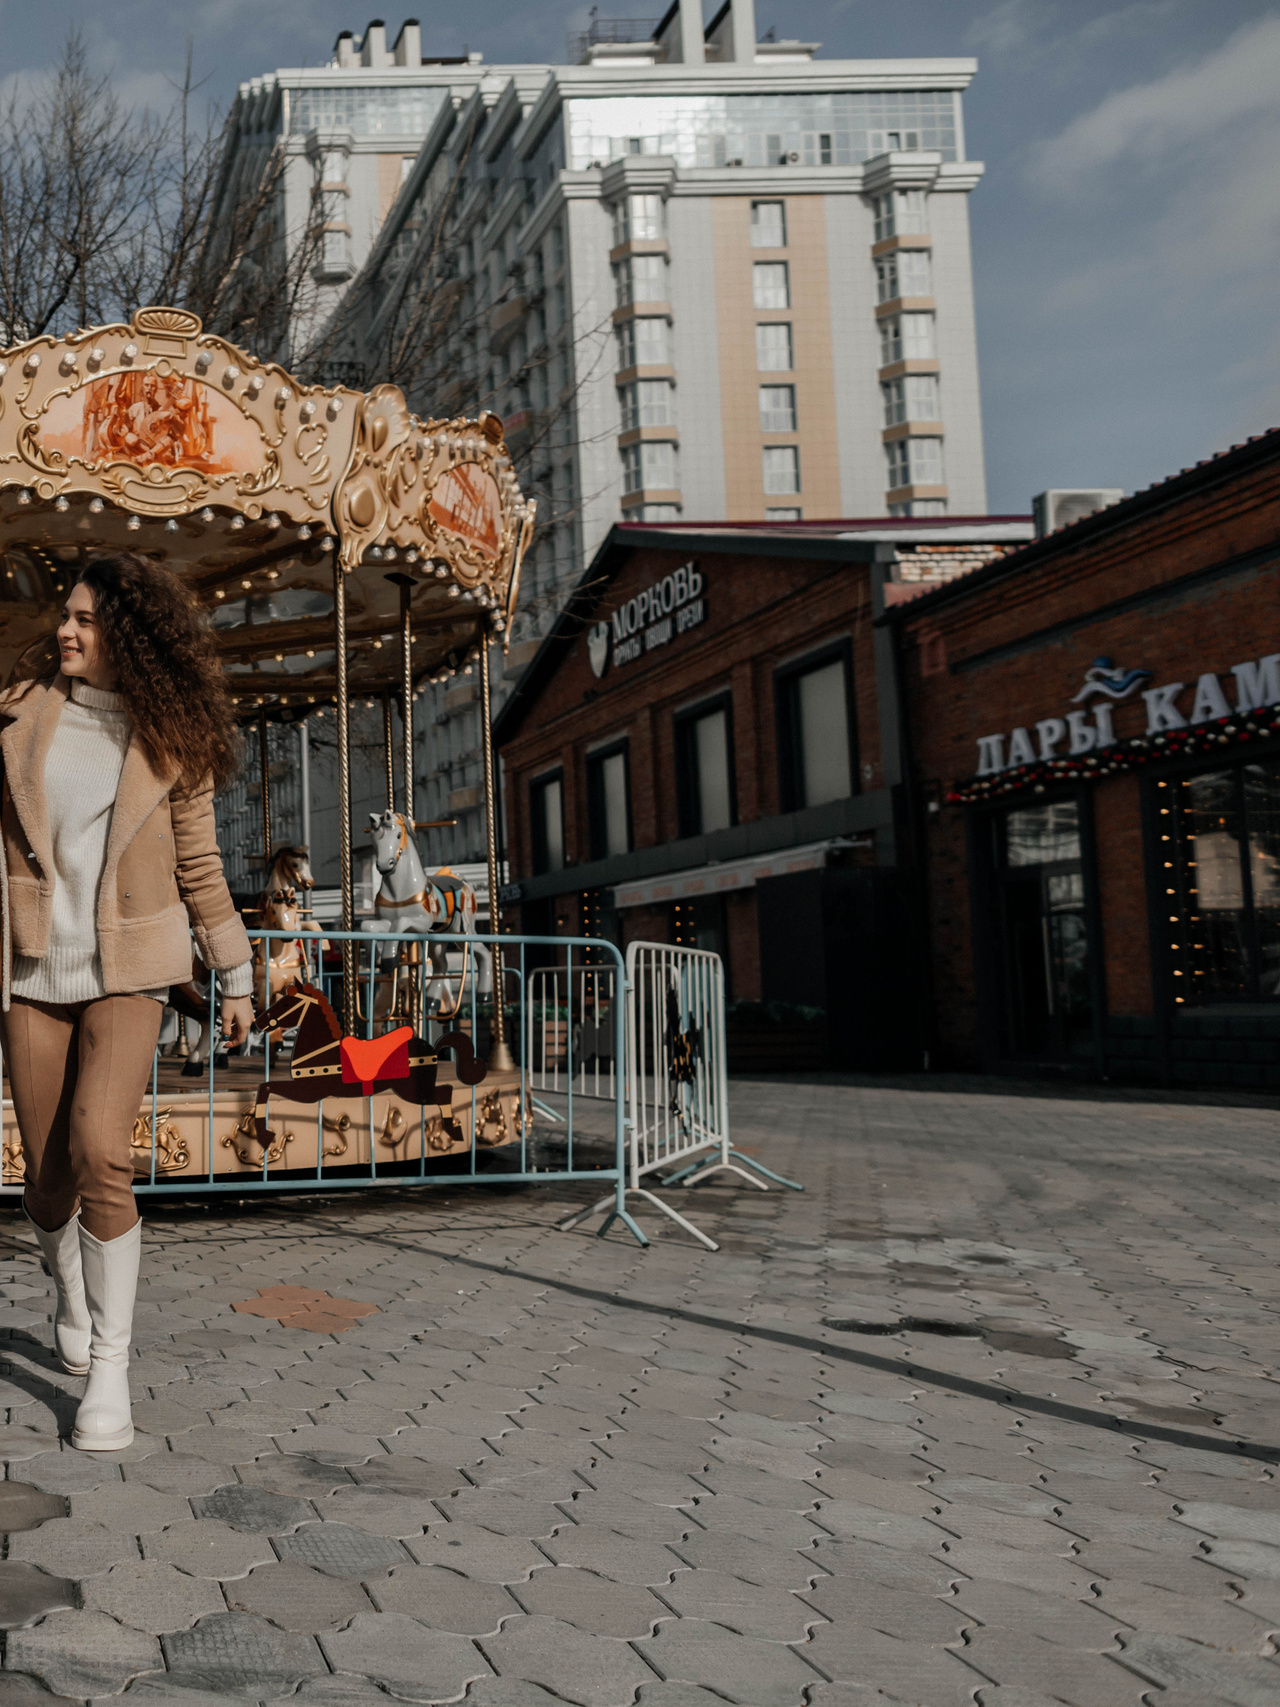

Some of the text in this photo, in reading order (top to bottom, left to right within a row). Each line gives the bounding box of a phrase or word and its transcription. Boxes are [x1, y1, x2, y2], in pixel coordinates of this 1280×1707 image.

[611, 561, 703, 644] МОРКОВЬ
[976, 653, 1280, 776] ДАРЫ КАМ
